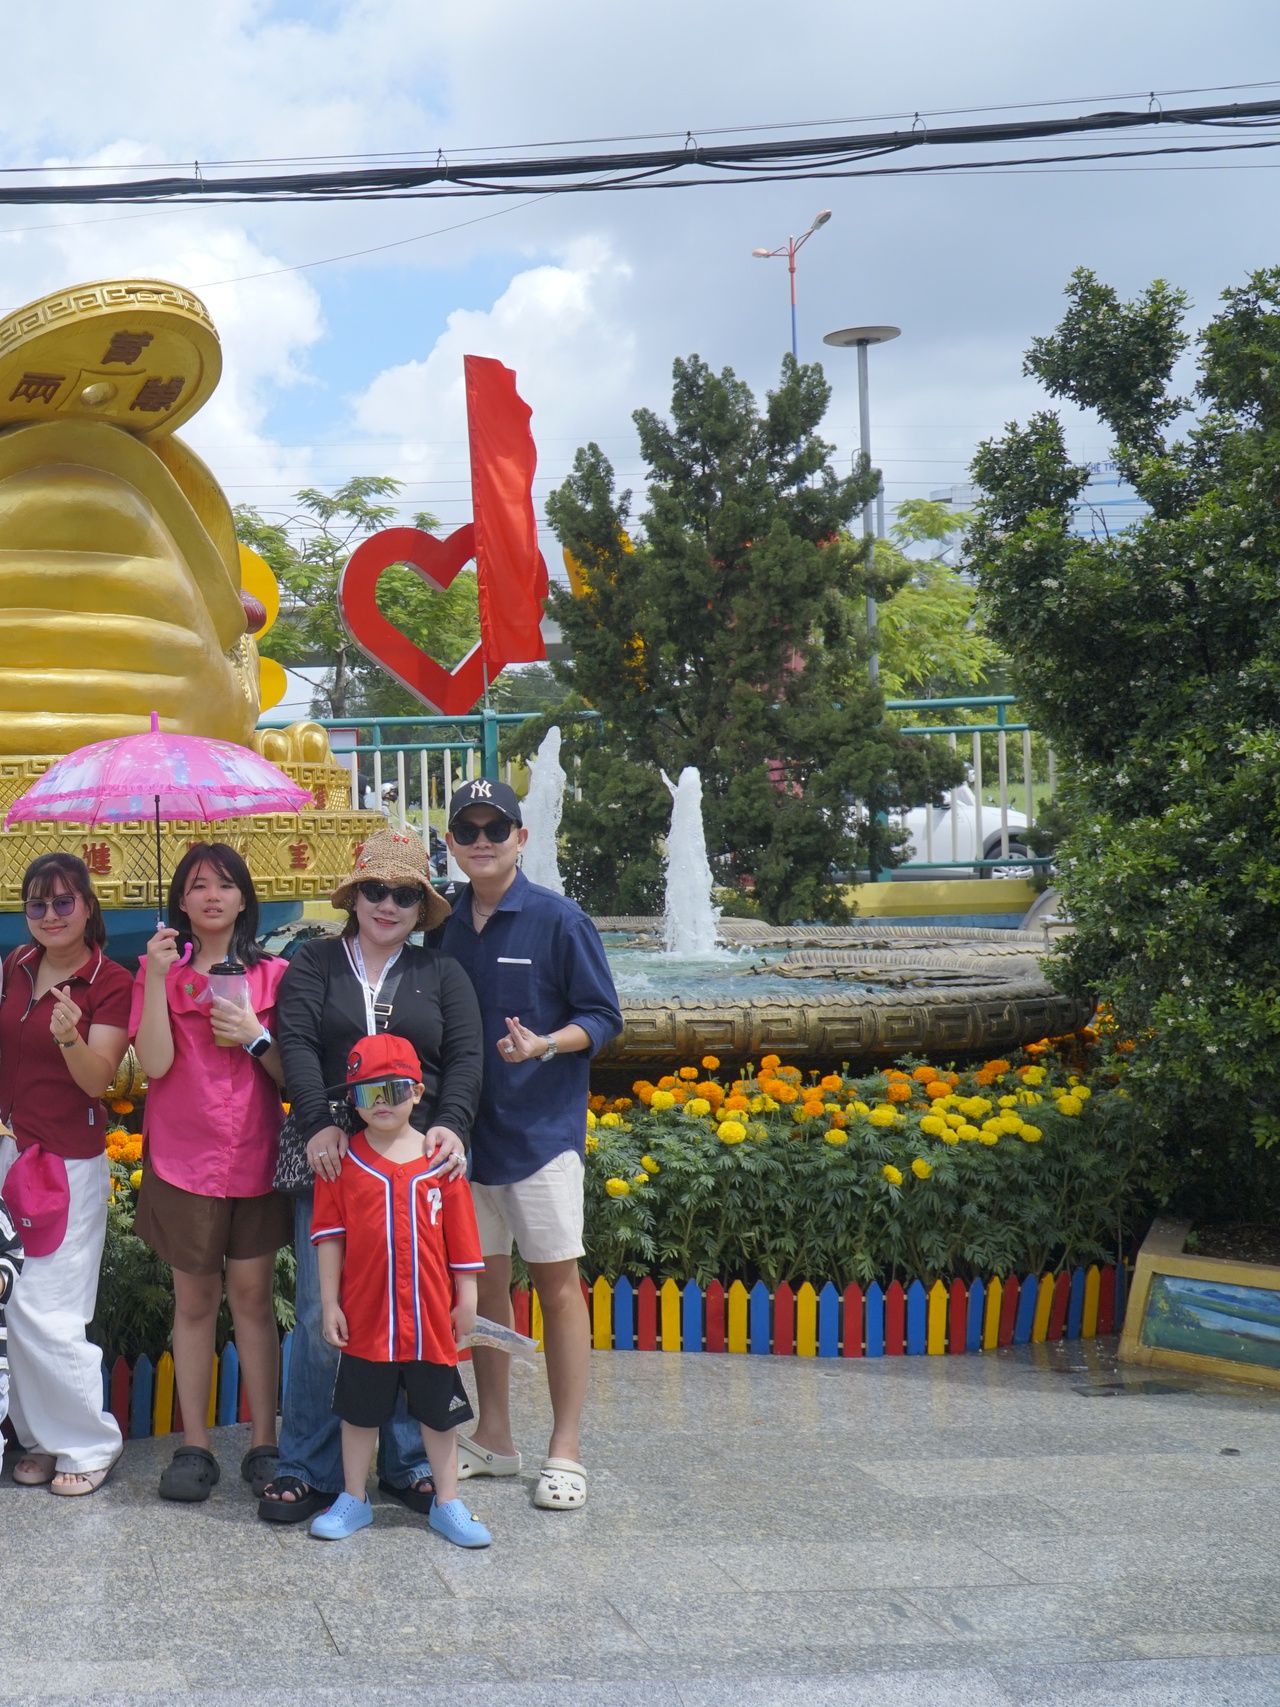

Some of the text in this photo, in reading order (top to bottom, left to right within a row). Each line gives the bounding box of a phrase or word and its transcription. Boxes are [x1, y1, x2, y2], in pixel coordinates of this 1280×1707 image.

[470, 779, 492, 799] NY
[83, 842, 112, 876] 進
[21, 1218, 32, 1228] D
